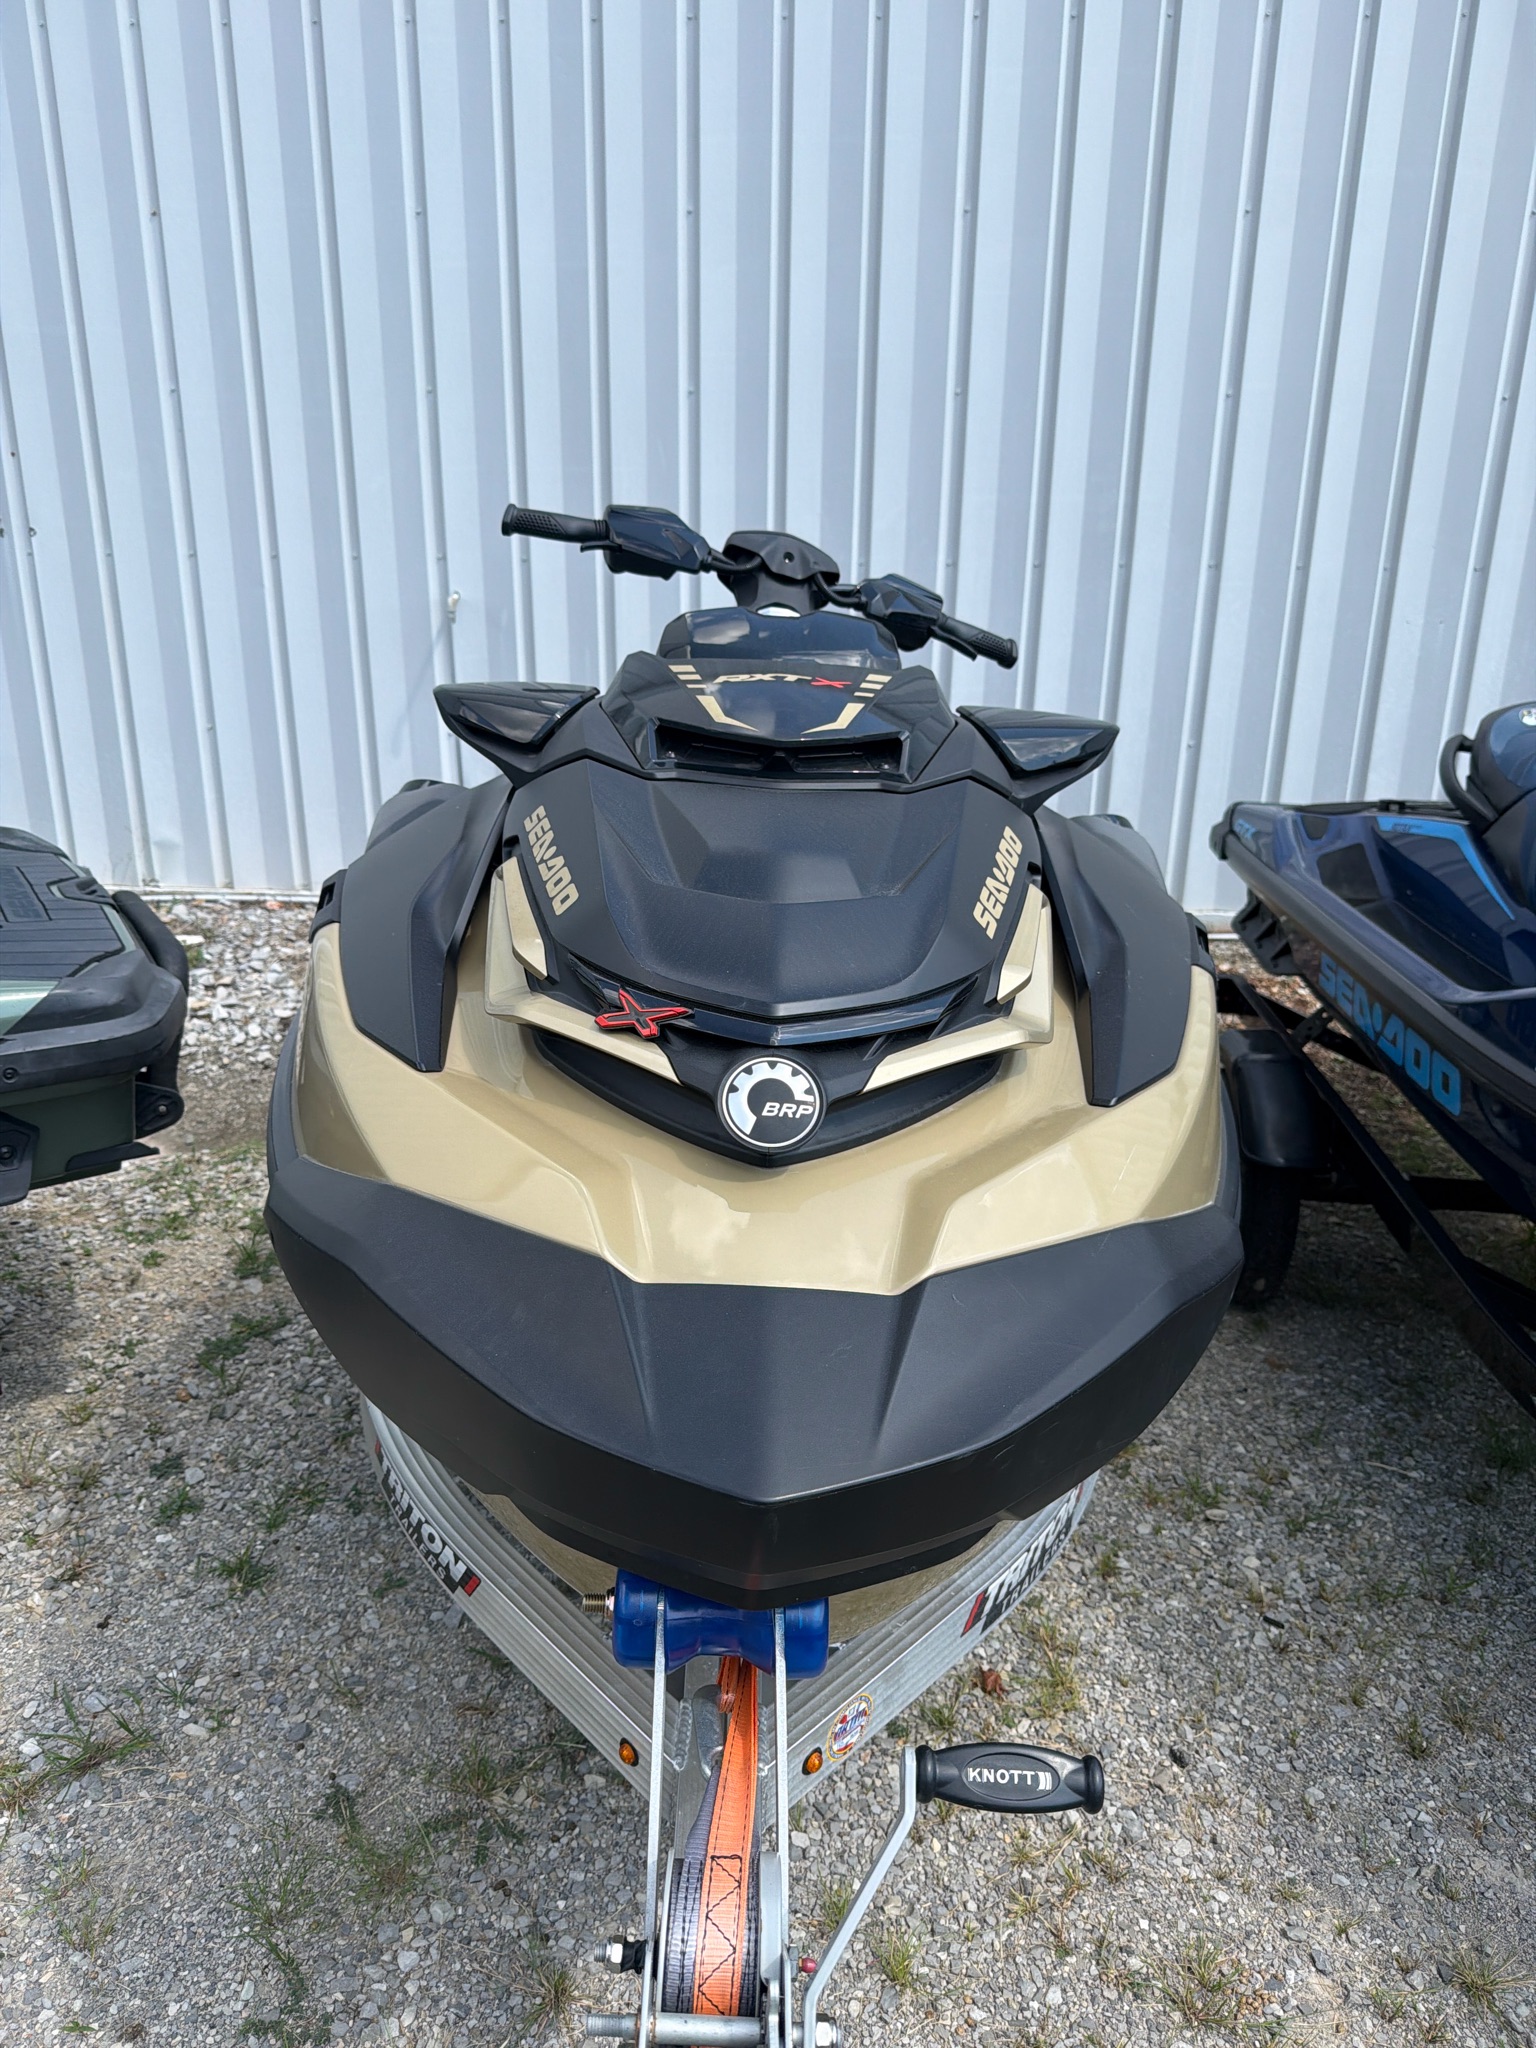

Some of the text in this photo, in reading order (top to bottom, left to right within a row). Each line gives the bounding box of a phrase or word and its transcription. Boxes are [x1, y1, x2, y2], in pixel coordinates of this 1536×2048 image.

[761, 1101, 814, 1119] BRP
[380, 1450, 467, 1583] TRITON
[390, 1493, 447, 1580] TRAILERS
[967, 1767, 1036, 1786] KNOTT
